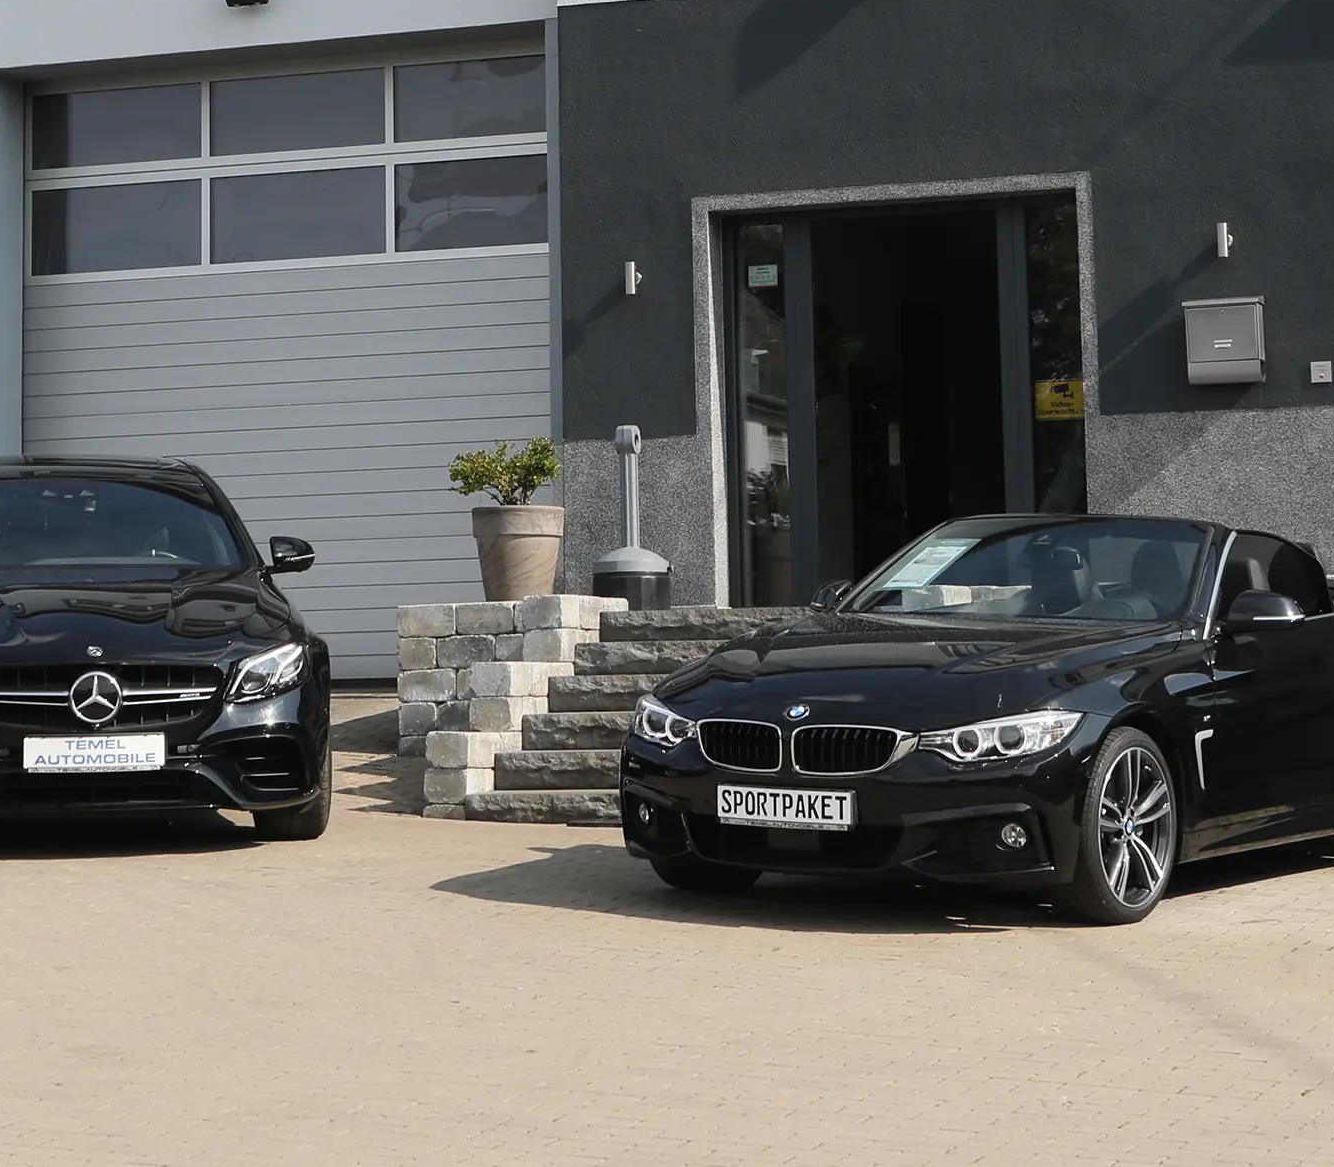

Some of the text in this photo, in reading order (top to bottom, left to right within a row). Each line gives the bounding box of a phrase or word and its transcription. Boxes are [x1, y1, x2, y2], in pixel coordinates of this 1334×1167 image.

[65, 739, 126, 750] TEMEL
[35, 753, 155, 765] AUTOMOBILE
[721, 789, 847, 820] SPORTPAKET
